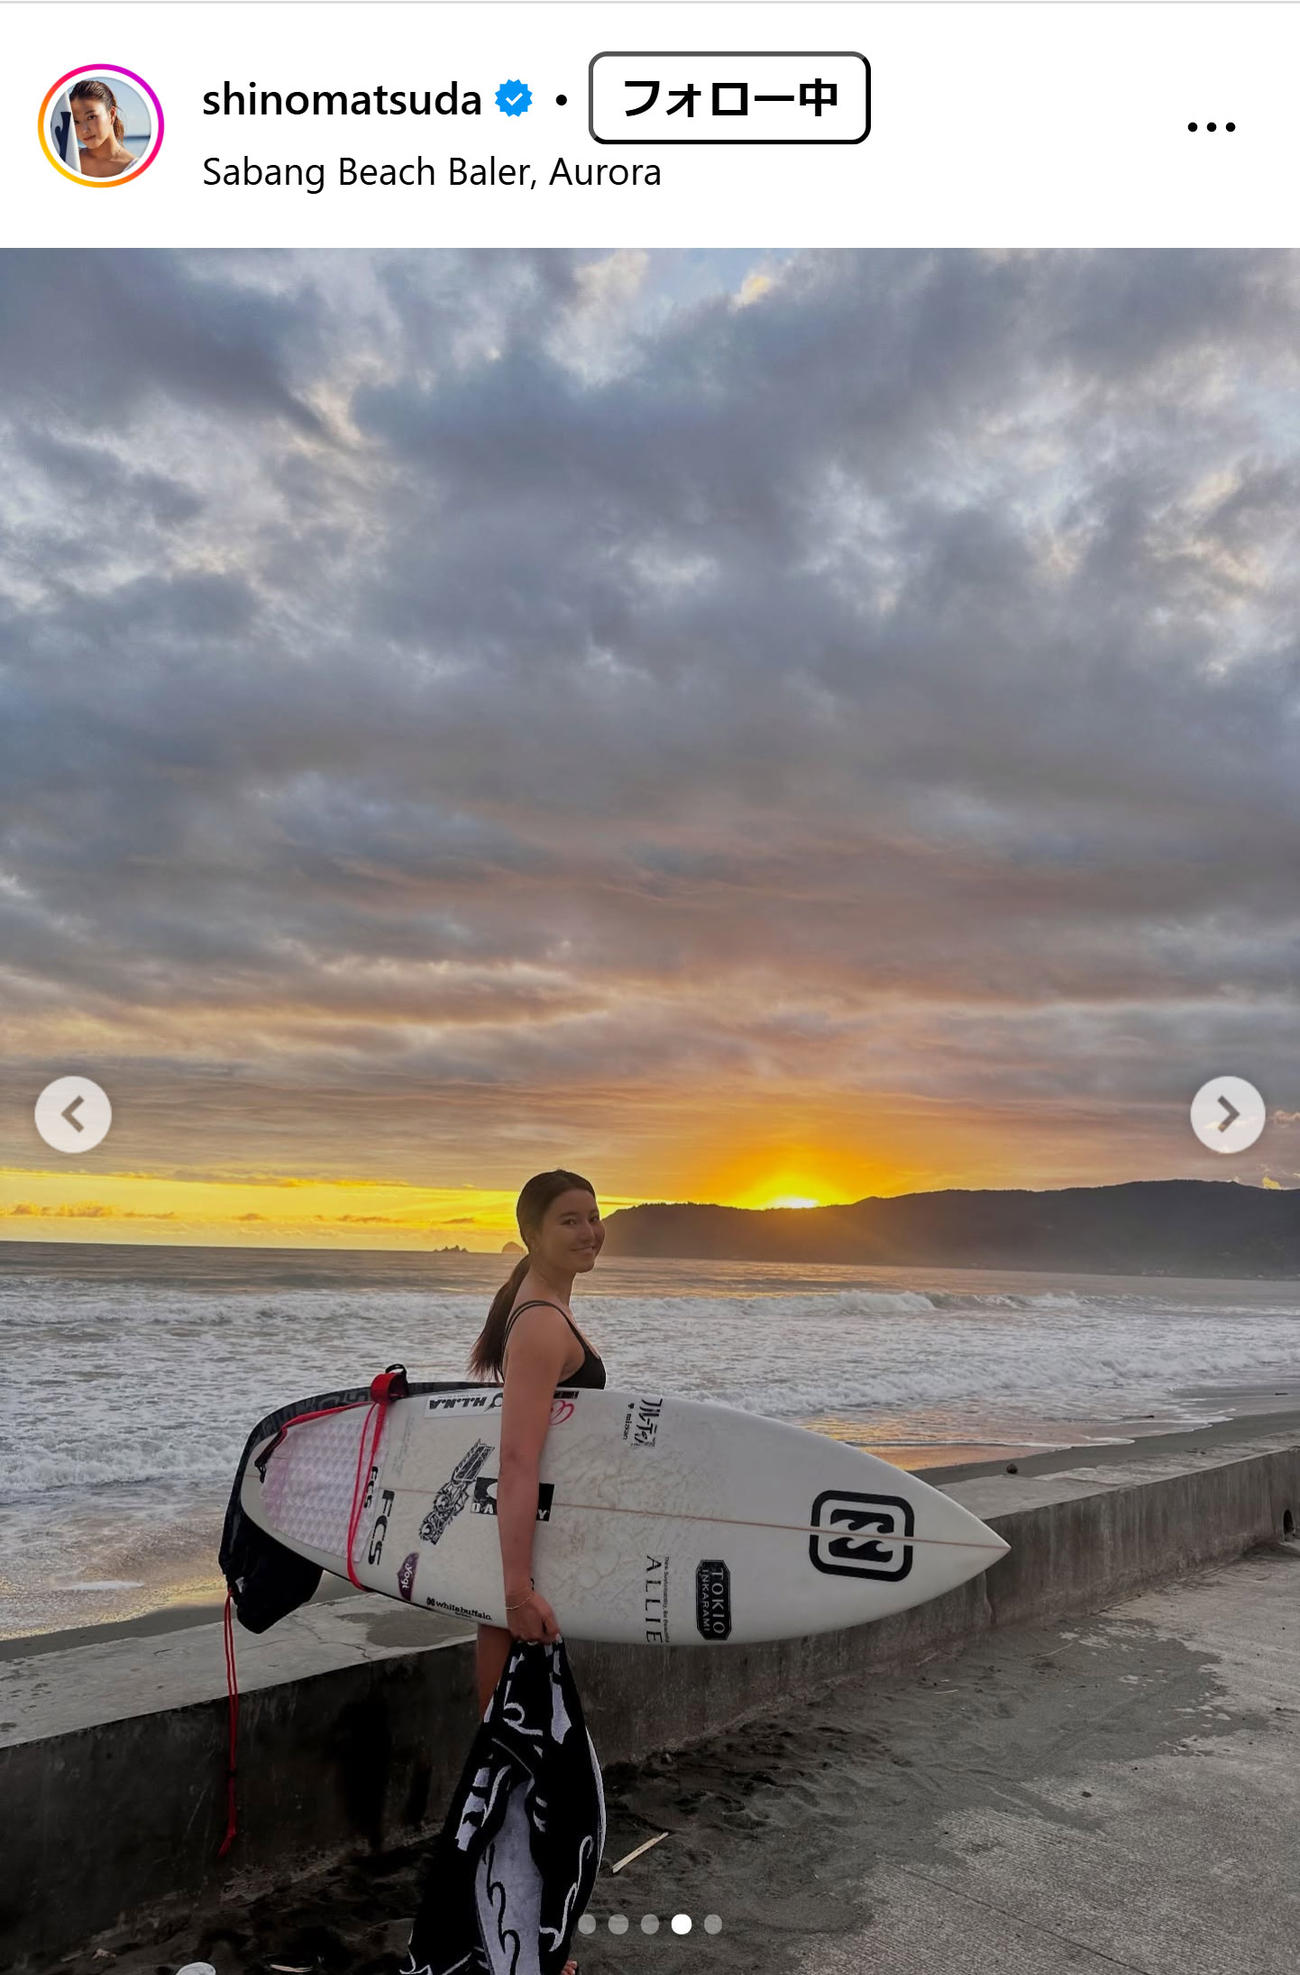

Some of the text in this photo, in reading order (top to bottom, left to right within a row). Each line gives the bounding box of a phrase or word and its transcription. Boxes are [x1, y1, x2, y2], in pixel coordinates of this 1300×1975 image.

[367, 1489, 395, 1566] FCS
[645, 1555, 663, 1643] ALLIE
[701, 1569, 711, 1632] INKARAMI
[711, 1567, 726, 1634] TOKIO
